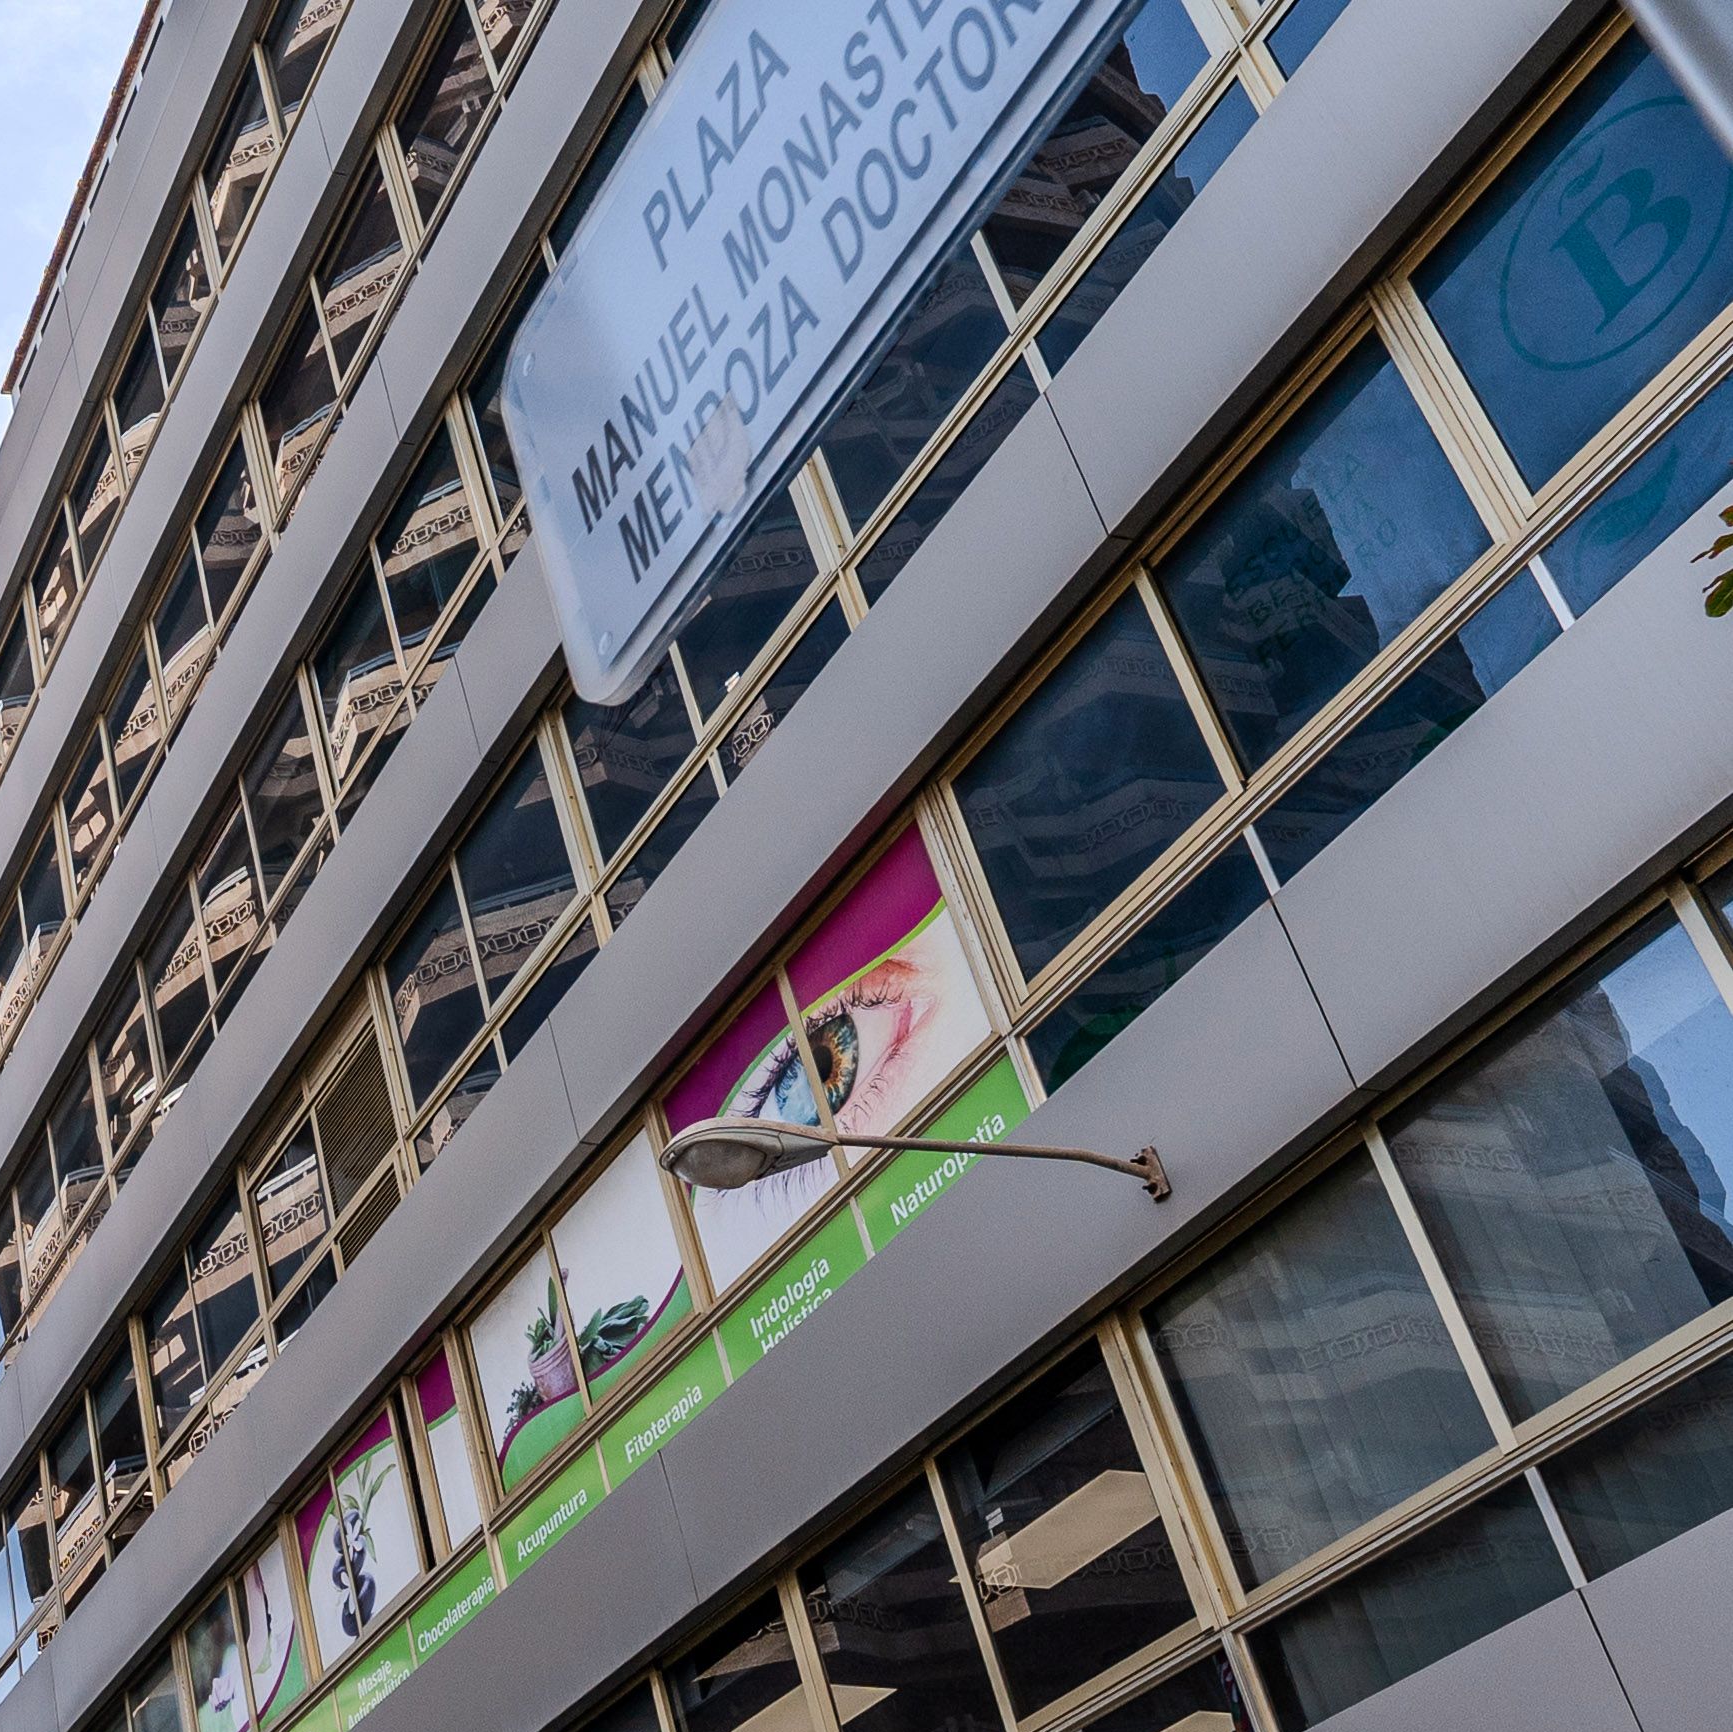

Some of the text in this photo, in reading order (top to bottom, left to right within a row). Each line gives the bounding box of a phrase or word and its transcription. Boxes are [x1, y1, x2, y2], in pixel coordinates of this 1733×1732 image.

[642, 29, 791, 272] PLAZA
[570, 283, 730, 534] MANUEL
[750, 1258, 831, 1339] Iridología
[624, 1384, 703, 1464] Fitoterapia
[516, 1488, 588, 1562] Acupuntura
[417, 1575, 495, 1653] Chocolaterapia
[357, 1660, 392, 1700] Masaje
